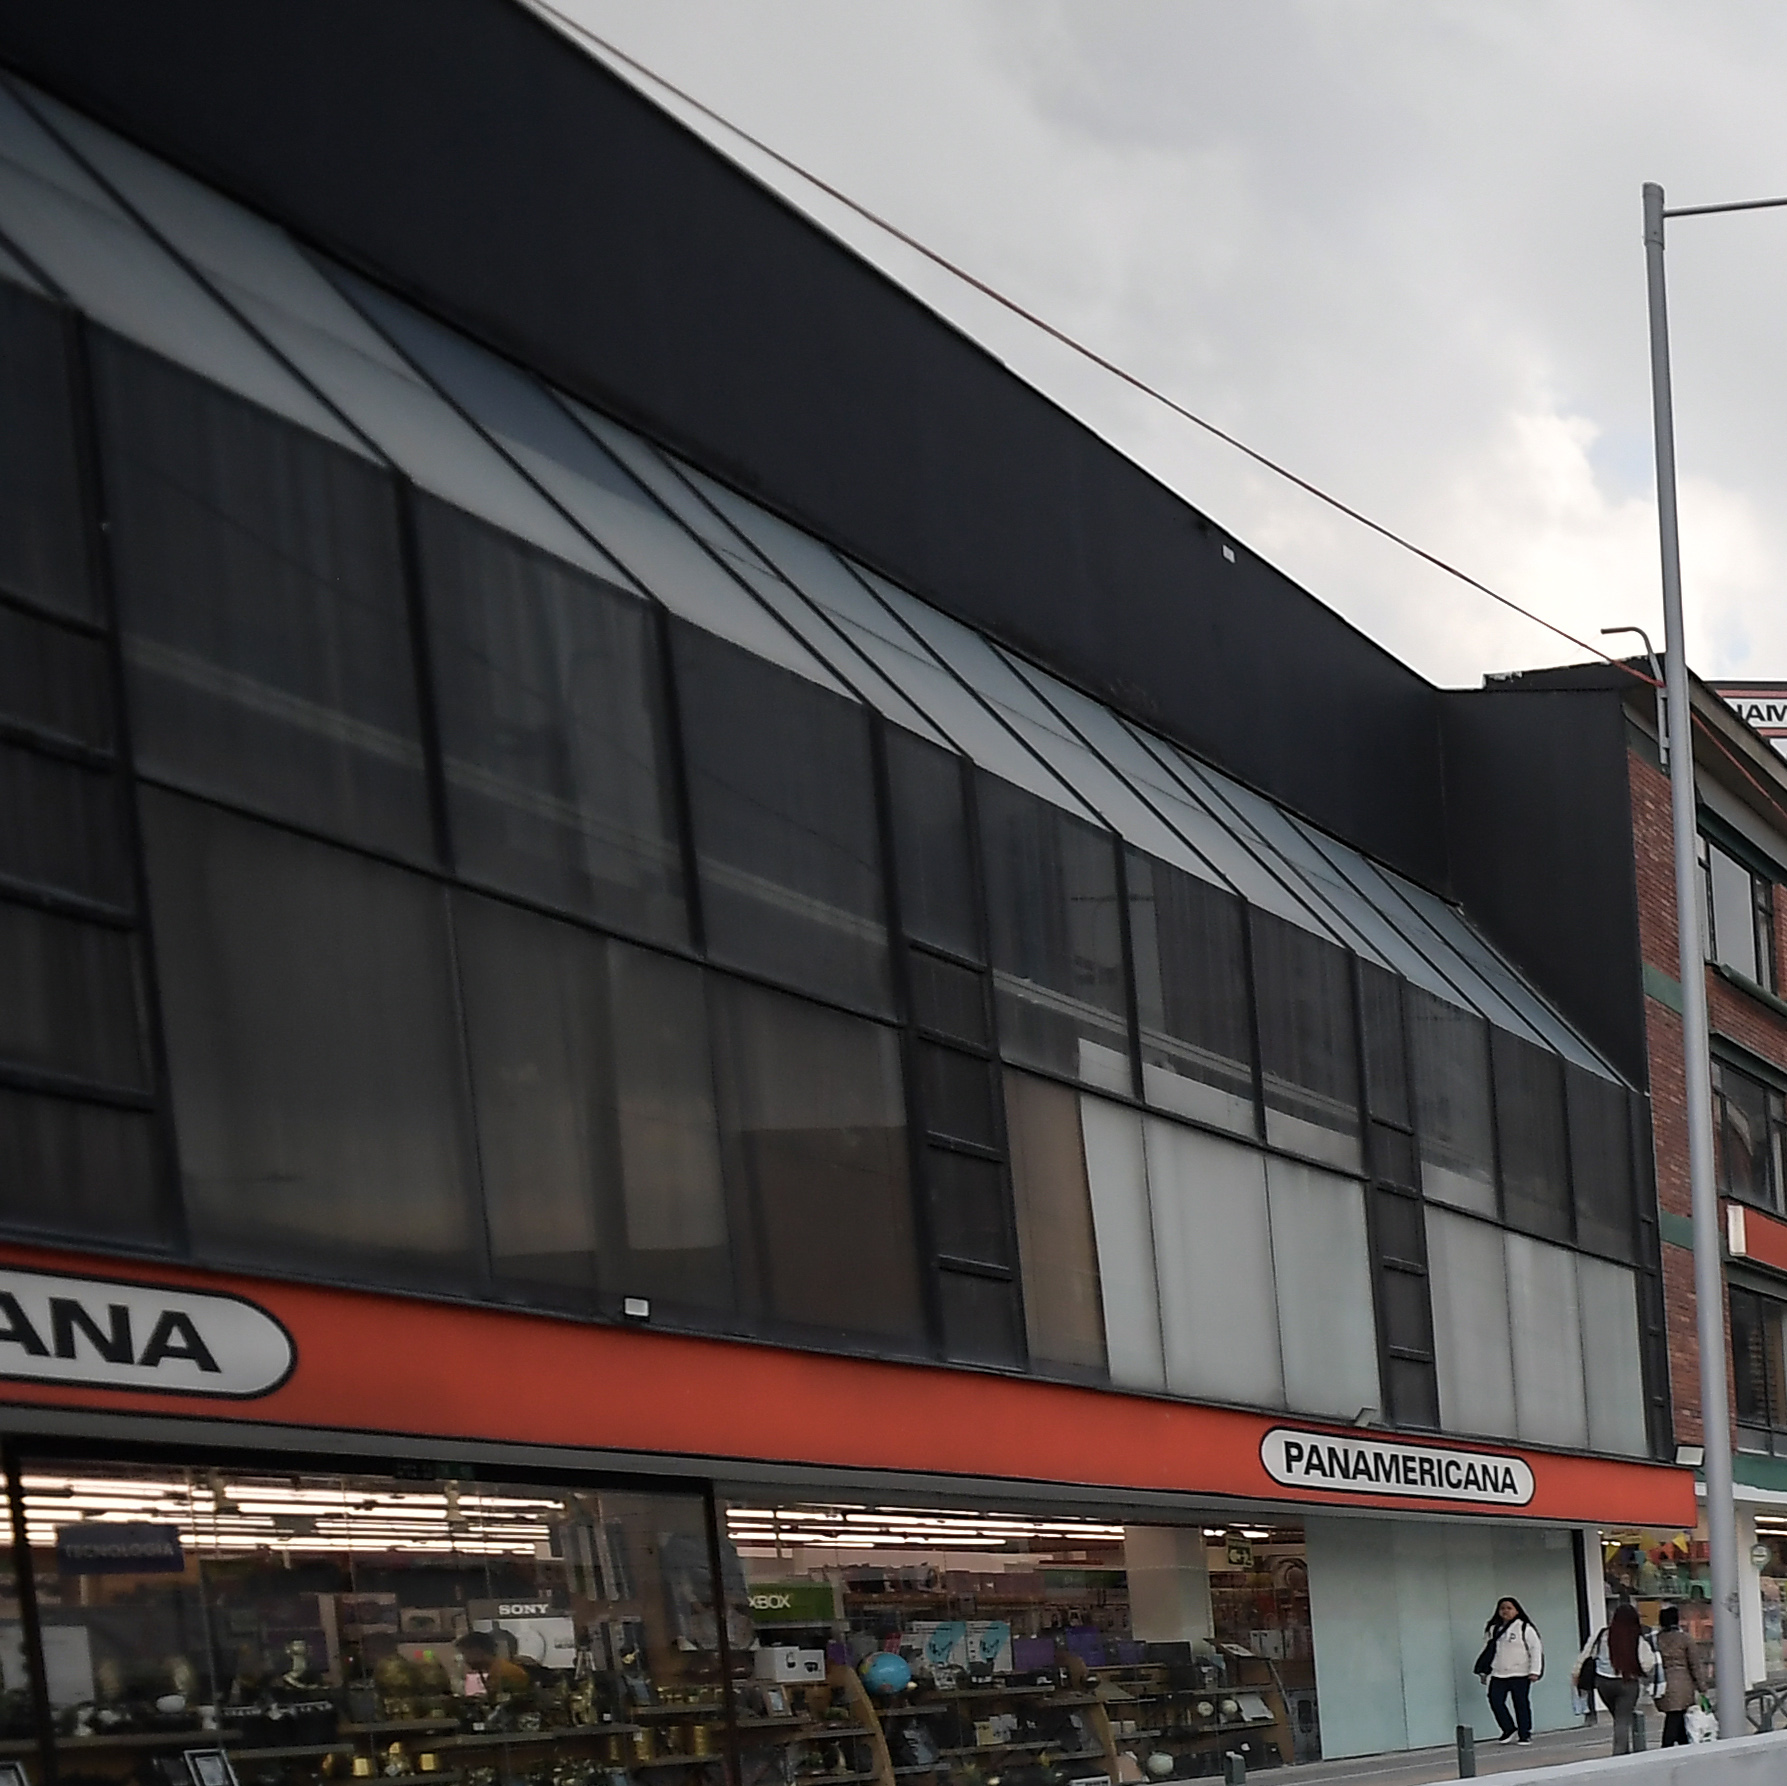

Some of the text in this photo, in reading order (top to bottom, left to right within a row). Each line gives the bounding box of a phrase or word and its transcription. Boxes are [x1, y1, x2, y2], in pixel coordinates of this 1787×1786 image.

[1283, 1440, 1519, 1496] PANAMERICANA
[499, 1603, 549, 1615] SONY
[747, 1593, 791, 1610] XBOX
